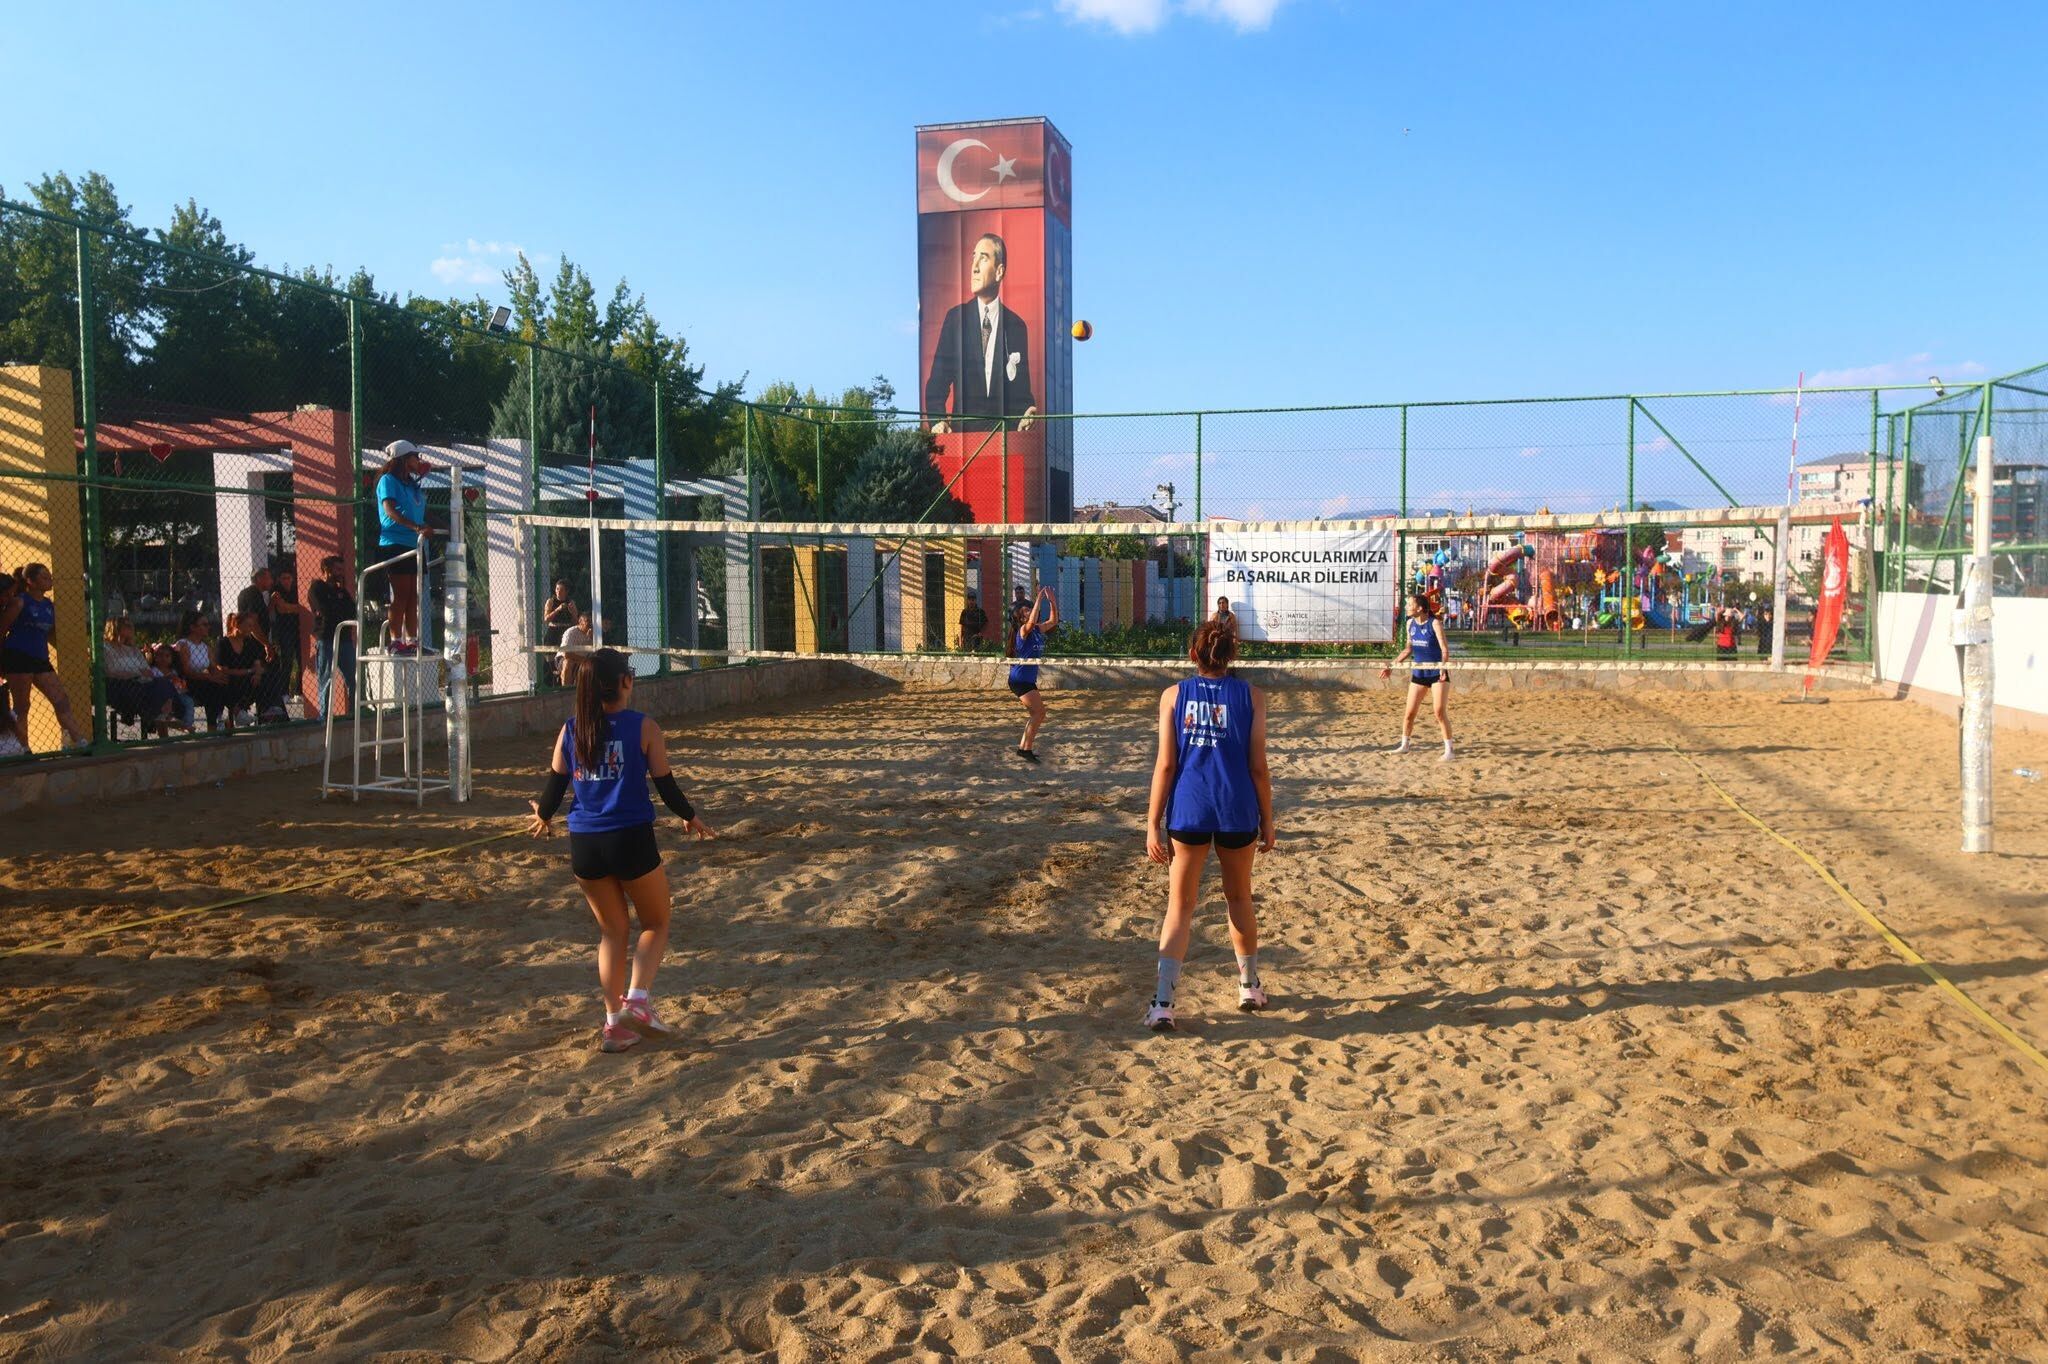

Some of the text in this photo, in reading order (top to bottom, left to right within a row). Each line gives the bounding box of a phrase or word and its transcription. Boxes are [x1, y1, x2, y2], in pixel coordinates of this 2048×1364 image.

[1215, 548, 1388, 563] TÜM SPORCULARIMIZA
[1227, 568, 1378, 585] BAŞARILAR DİLERİM
